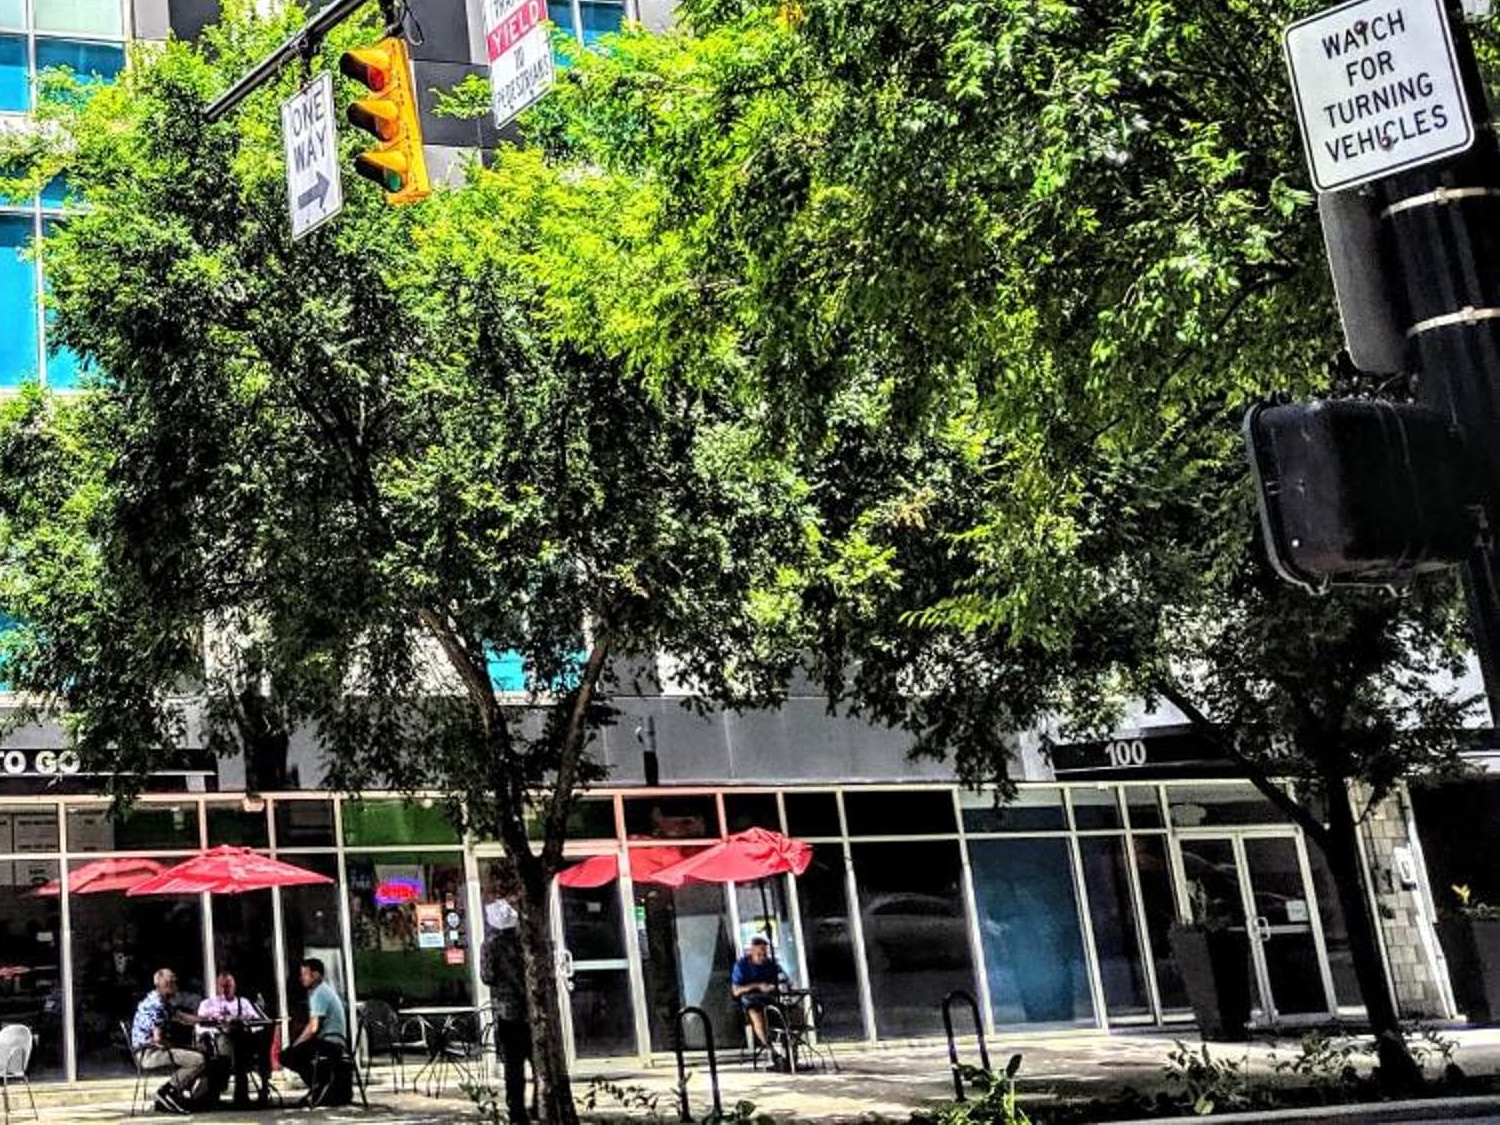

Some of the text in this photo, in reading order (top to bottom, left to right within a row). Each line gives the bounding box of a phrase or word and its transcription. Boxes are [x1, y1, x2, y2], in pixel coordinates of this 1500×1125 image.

[1321, 9, 1406, 60] WATCH
[496, 53, 551, 111] PEDESTRIANS
[1345, 50, 1396, 88] FOR
[291, 92, 325, 138] ONE
[1323, 72, 1434, 129] TURNING
[294, 131, 327, 174] WAY
[1325, 104, 1449, 164] VEHICLES
[35, 749, 82, 775] GO
[1105, 740, 1146, 767] 100
